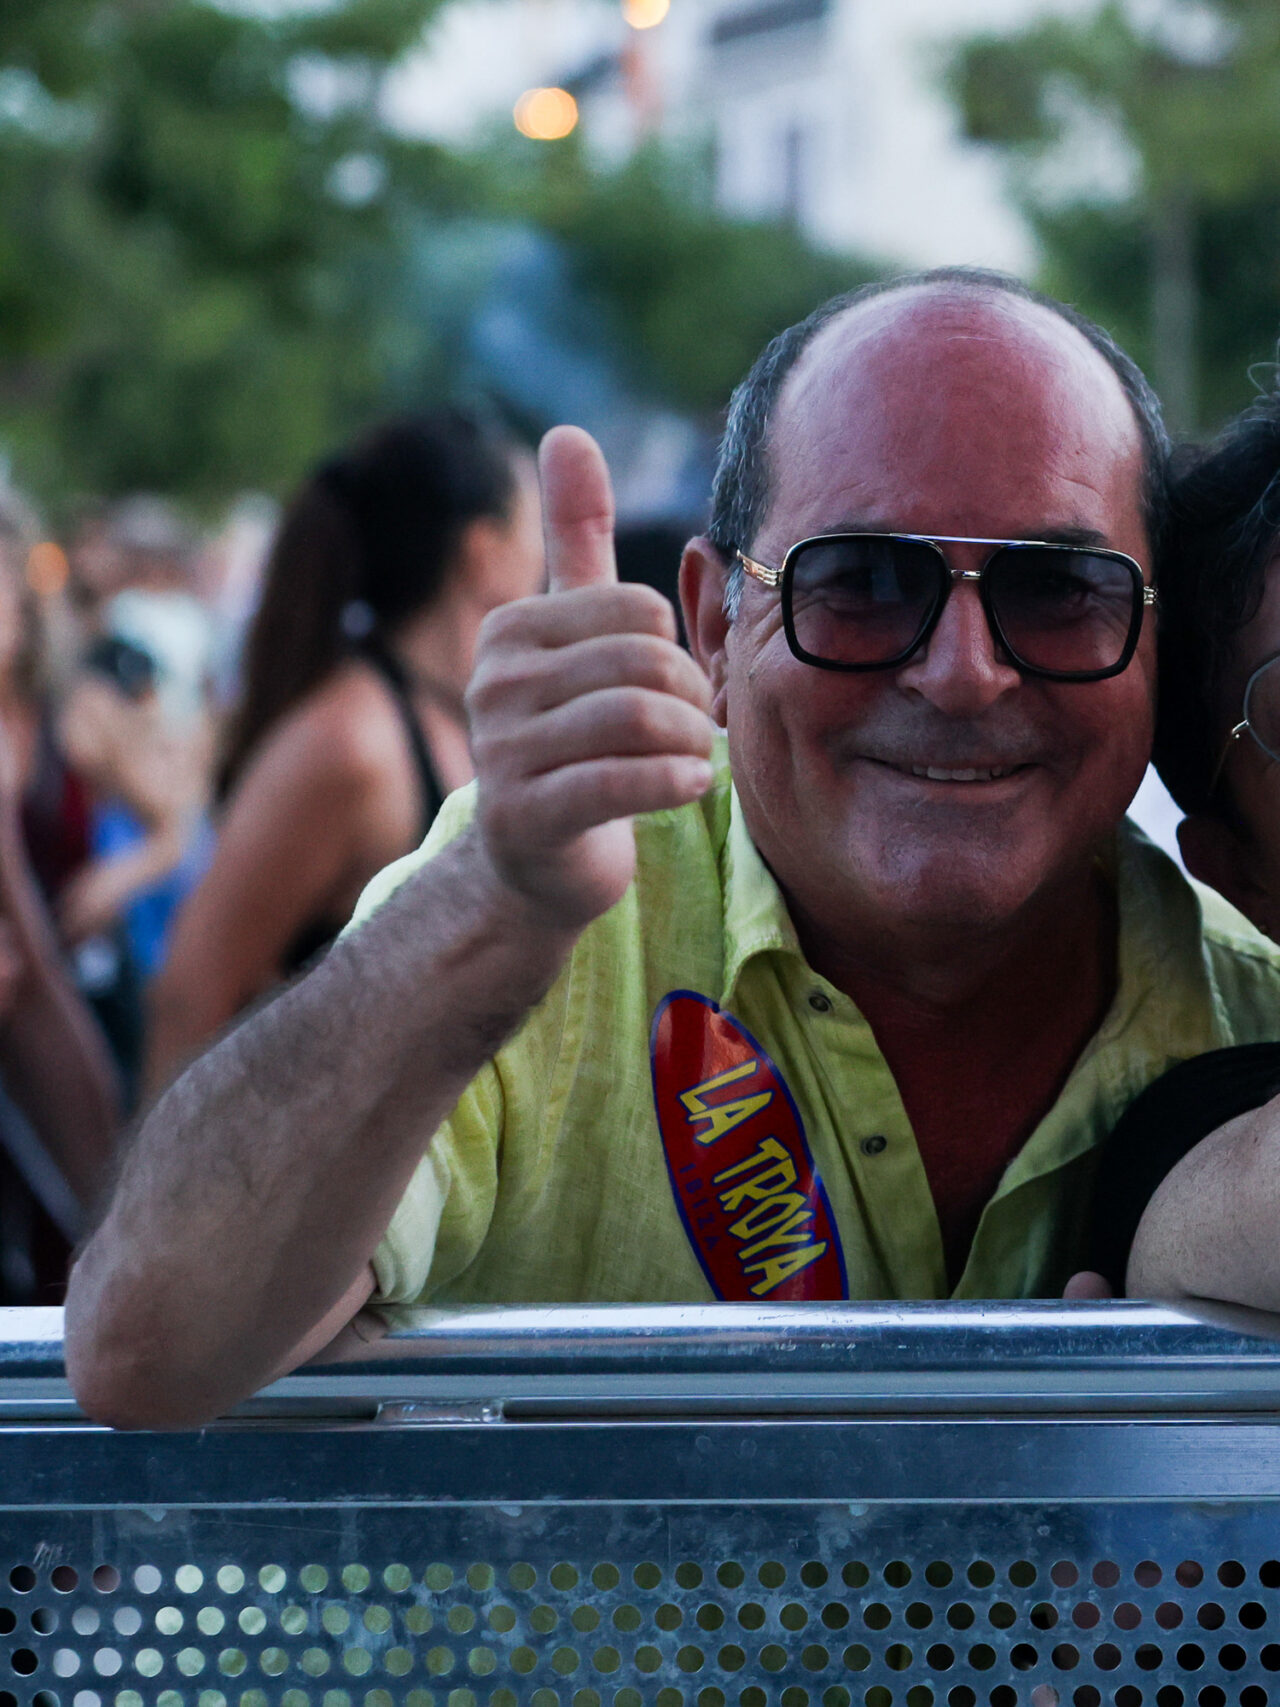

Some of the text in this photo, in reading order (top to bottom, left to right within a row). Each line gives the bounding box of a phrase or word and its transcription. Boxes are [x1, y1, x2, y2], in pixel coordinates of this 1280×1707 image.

[677, 1058, 829, 1296] LA TROYA
[679, 1163, 721, 1250] IBIZA
